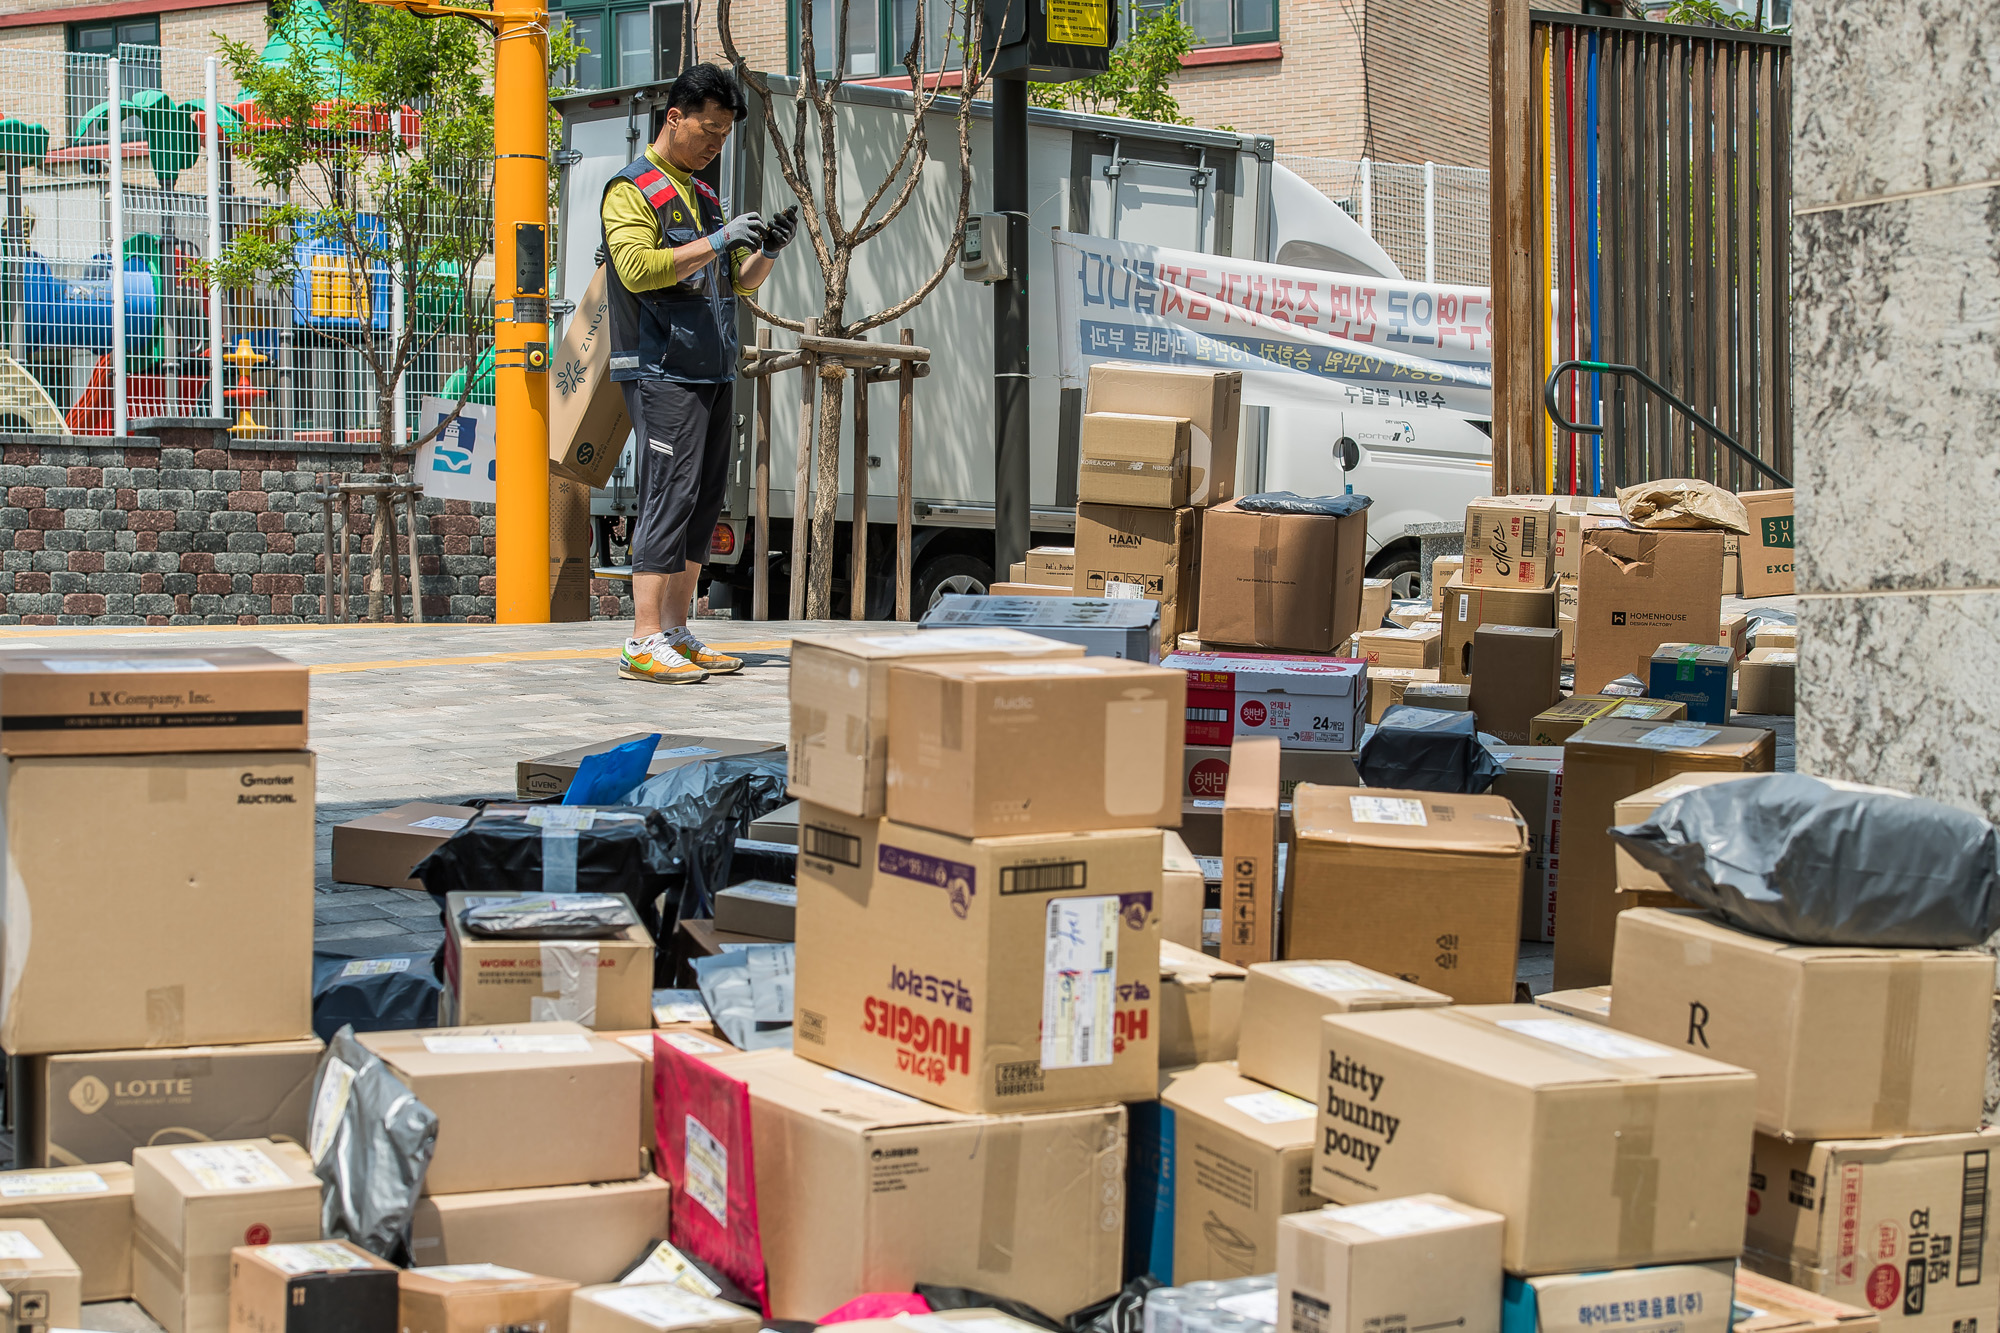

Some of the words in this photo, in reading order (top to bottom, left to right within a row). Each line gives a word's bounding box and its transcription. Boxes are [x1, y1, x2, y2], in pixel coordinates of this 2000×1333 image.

[580, 303, 608, 353] ZINUS
[578, 444, 594, 464] SS
[1109, 534, 1142, 545] HAAN
[1489, 520, 1515, 577] 에이스
[1630, 612, 1687, 622] HOMENHOUSE
[89, 691, 112, 707] LX
[188, 690, 216, 705] Inc.
[1243, 707, 1265, 721] 햇반
[1270, 701, 1291, 710] 언제나
[1271, 709, 1291, 718] 맛있는
[1313, 716, 1345, 732] 24개입
[531, 780, 558, 790] LIVENS
[479, 958, 516, 968] WORK
[890, 964, 973, 1013] 맥스드라이
[864, 995, 971, 1076] HUGGIES
[1686, 1000, 1711, 1049] R
[897, 1048, 947, 1086] 하기스
[1328, 1049, 1385, 1102] kitty
[114, 1078, 193, 1097] LOTTE
[1326, 1085, 1401, 1144] bunny
[1323, 1126, 1381, 1172] pony
[1908, 1206, 1931, 1255] 마요
[1927, 1233, 1953, 1284] 덮밥
[1578, 1291, 1703, 1327] 하이트진로음료(주)
